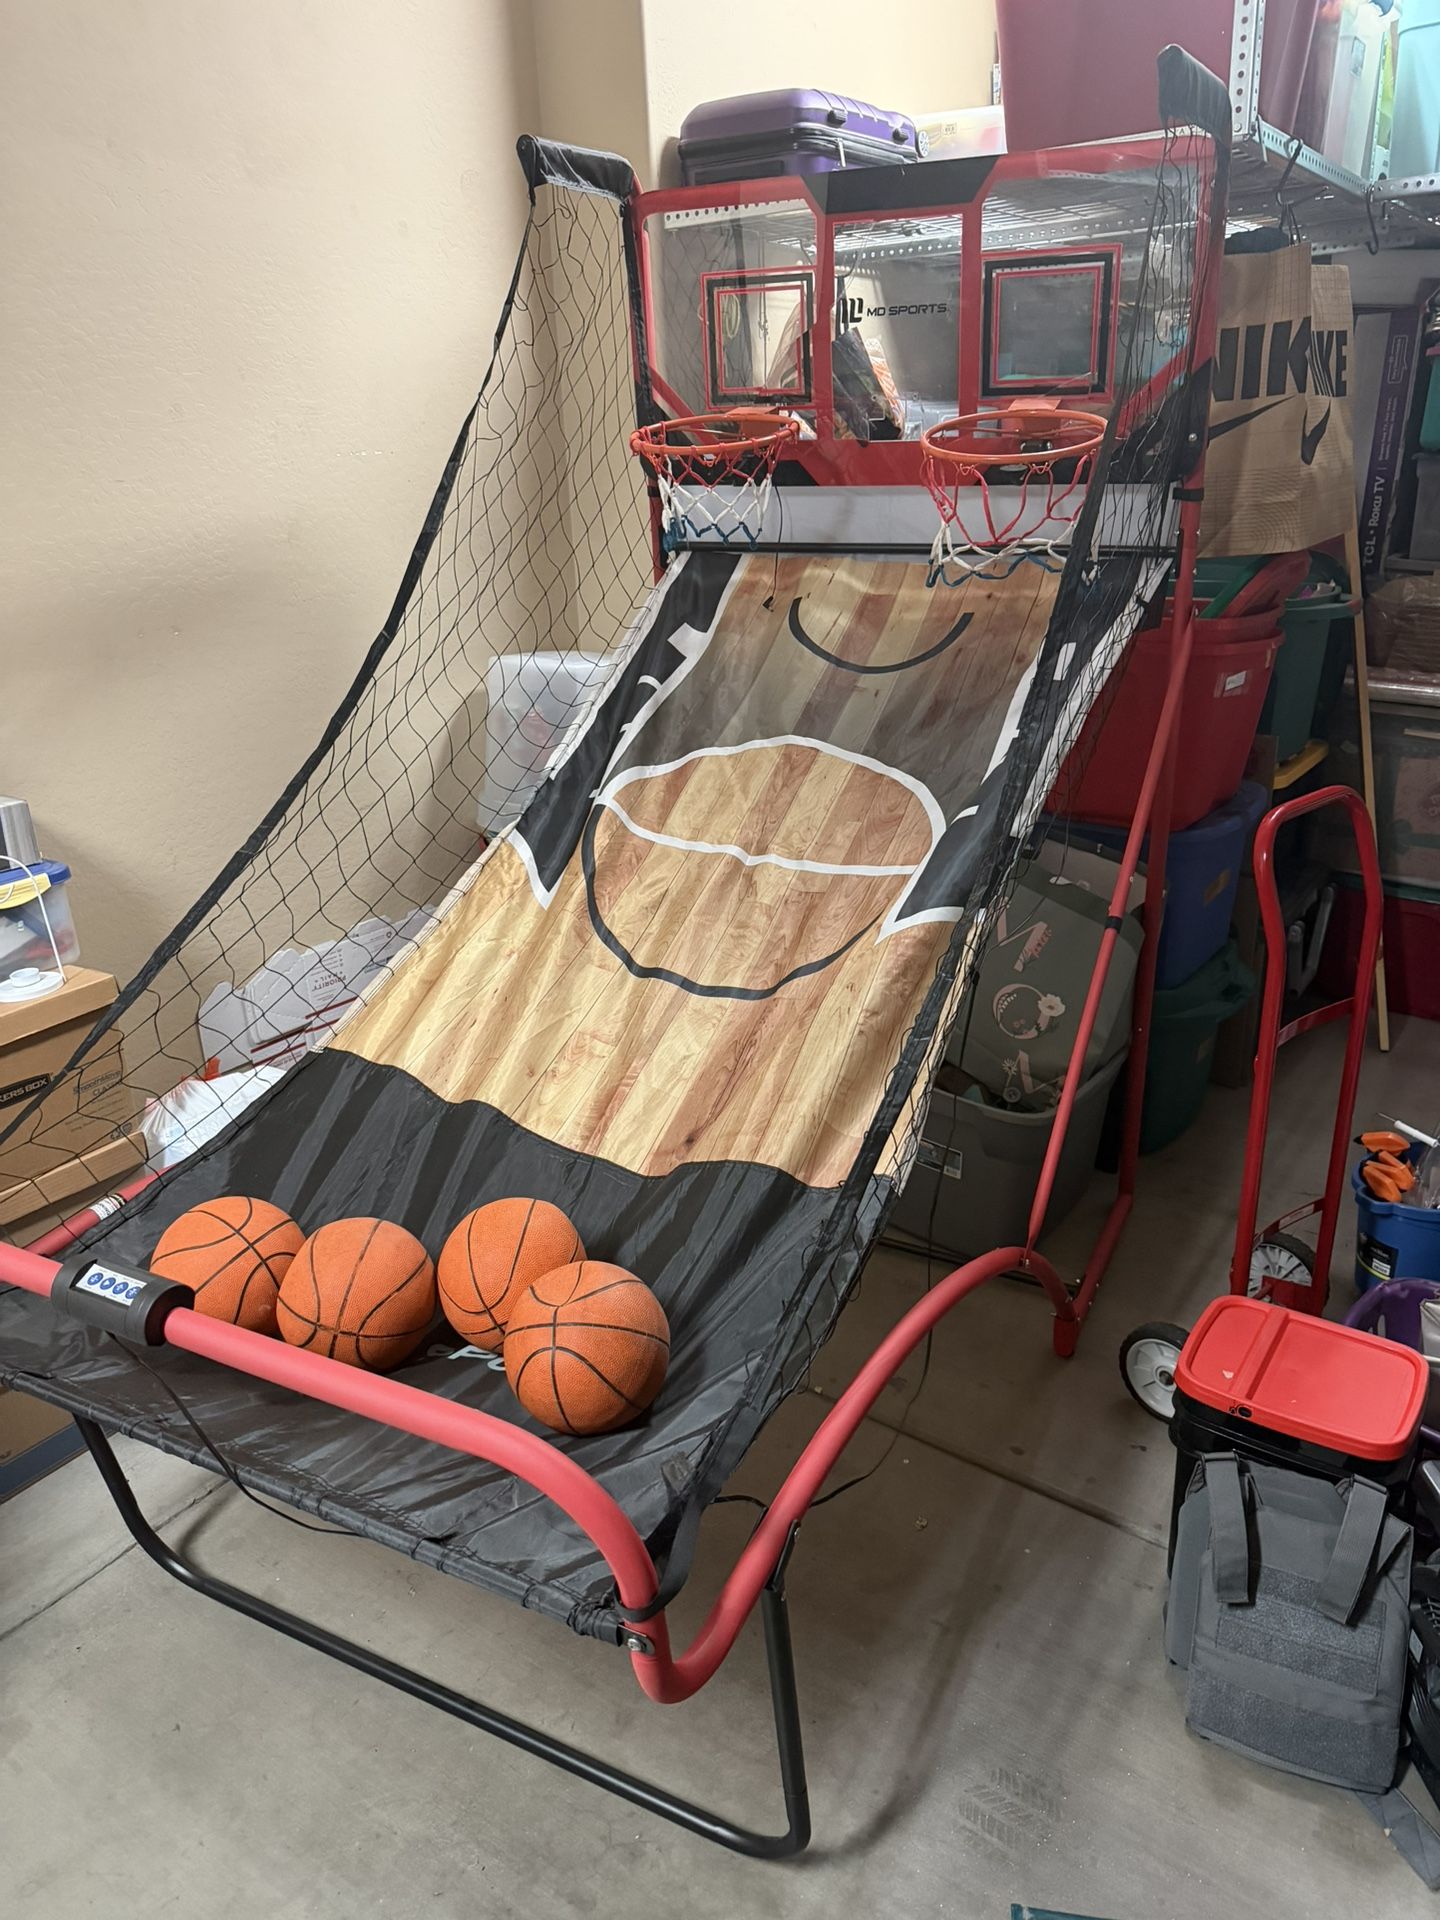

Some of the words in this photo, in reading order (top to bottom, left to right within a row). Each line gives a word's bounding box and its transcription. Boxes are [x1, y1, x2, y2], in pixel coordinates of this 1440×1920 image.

[866, 307, 886, 317] MD
[888, 303, 947, 316] SPORTS
[1362, 536, 1376, 567] TCL
[1373, 476, 1385, 494] TV
[312, 975, 347, 992] PRIORITY
[25, 1078, 48, 1092] BOX
